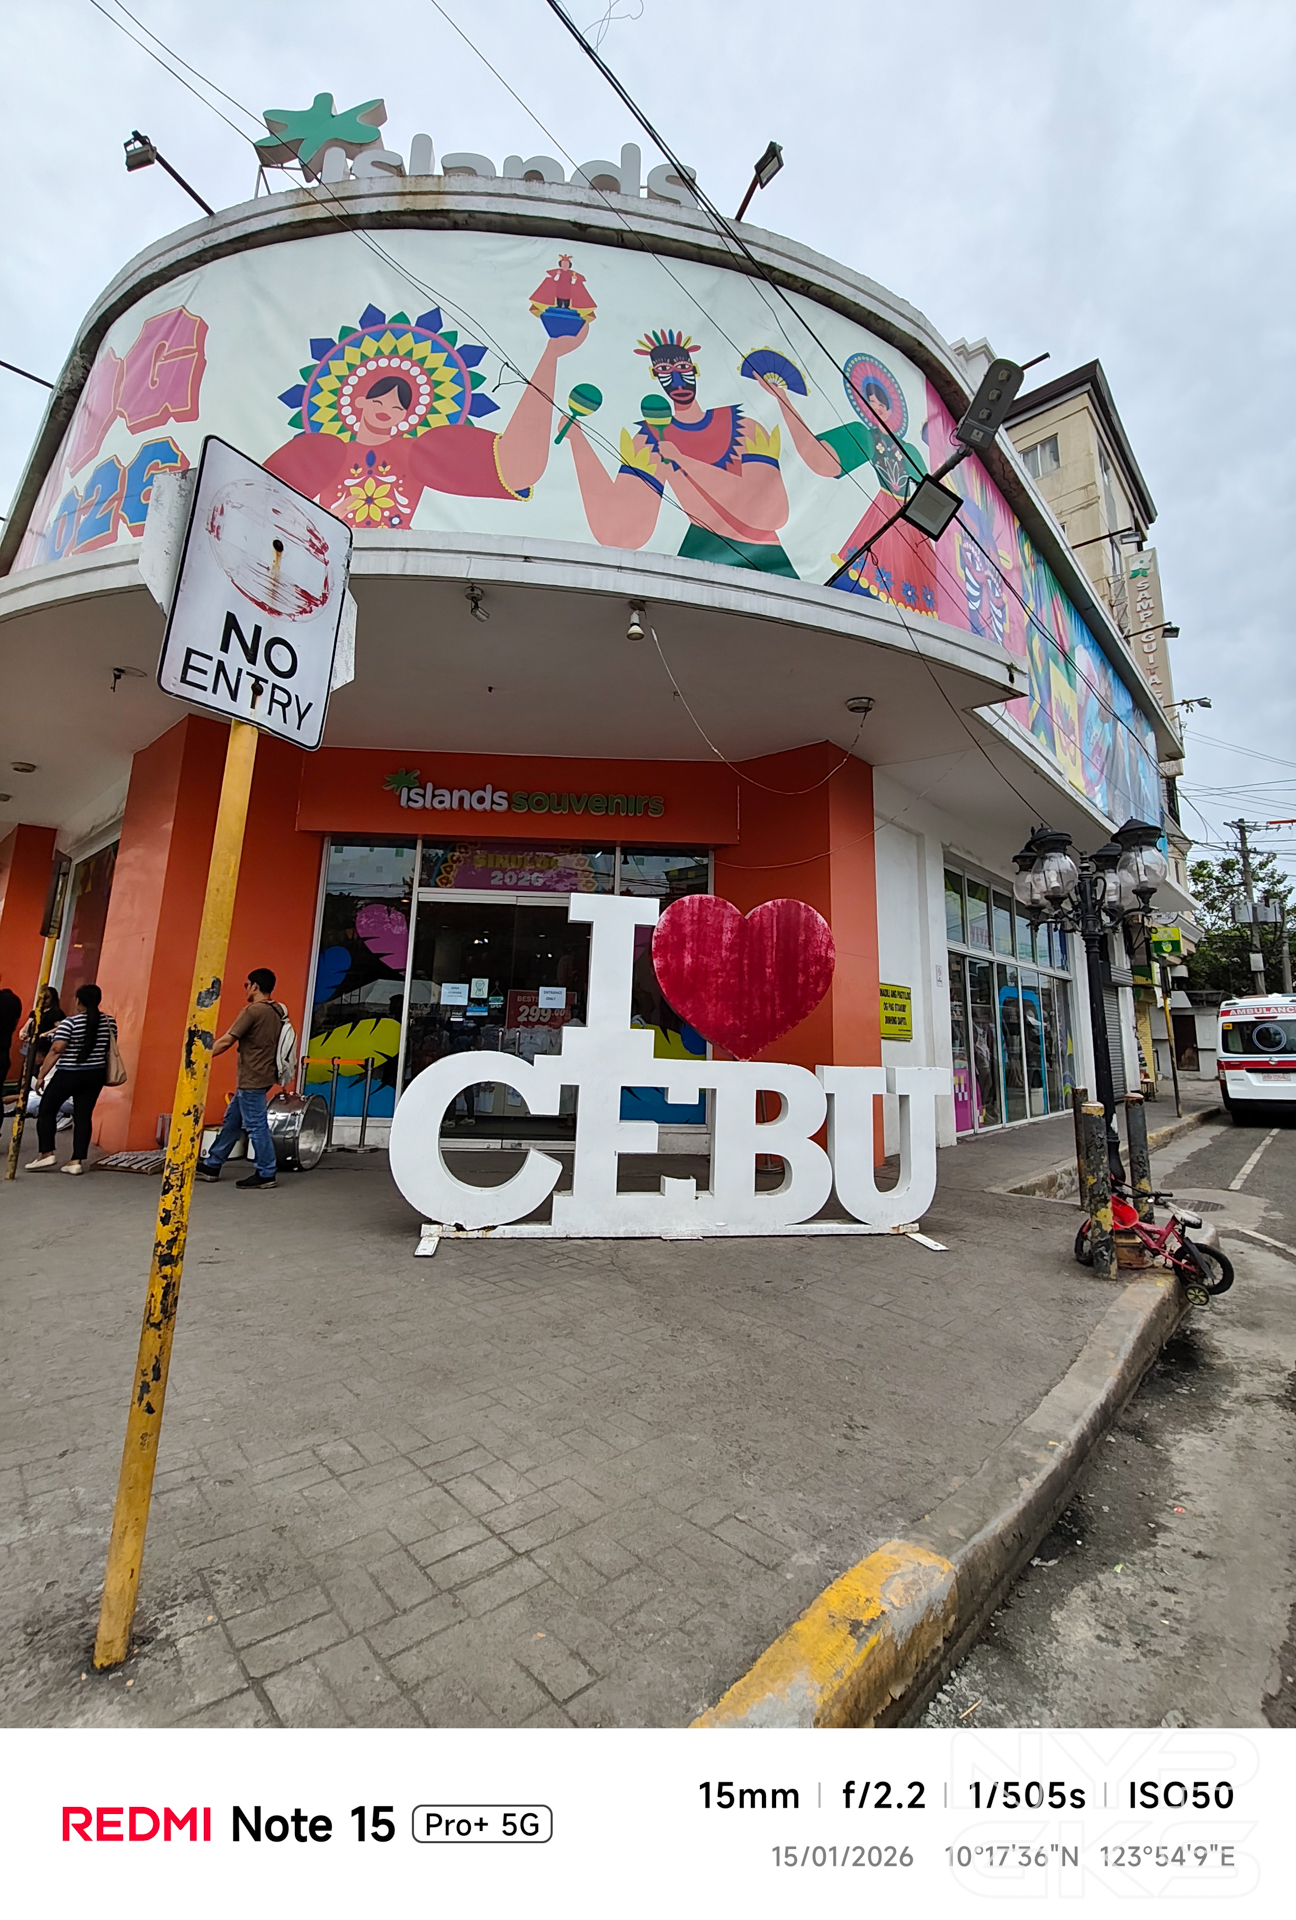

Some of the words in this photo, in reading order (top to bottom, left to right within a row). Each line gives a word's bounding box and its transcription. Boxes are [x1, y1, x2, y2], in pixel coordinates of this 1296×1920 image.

[320, 133, 697, 207] islands
[219, 610, 298, 680] NO
[1136, 581, 1163, 686] SAMPAGUITA
[180, 646, 314, 731] ENTRY
[400, 782, 508, 811] islands
[511, 791, 665, 817] souvenirs
[490, 870, 544, 887] 2026
[562, 893, 661, 1056] I
[1229, 1006, 1296, 1016] AMBULANC
[390, 1051, 952, 1234] CEBU
